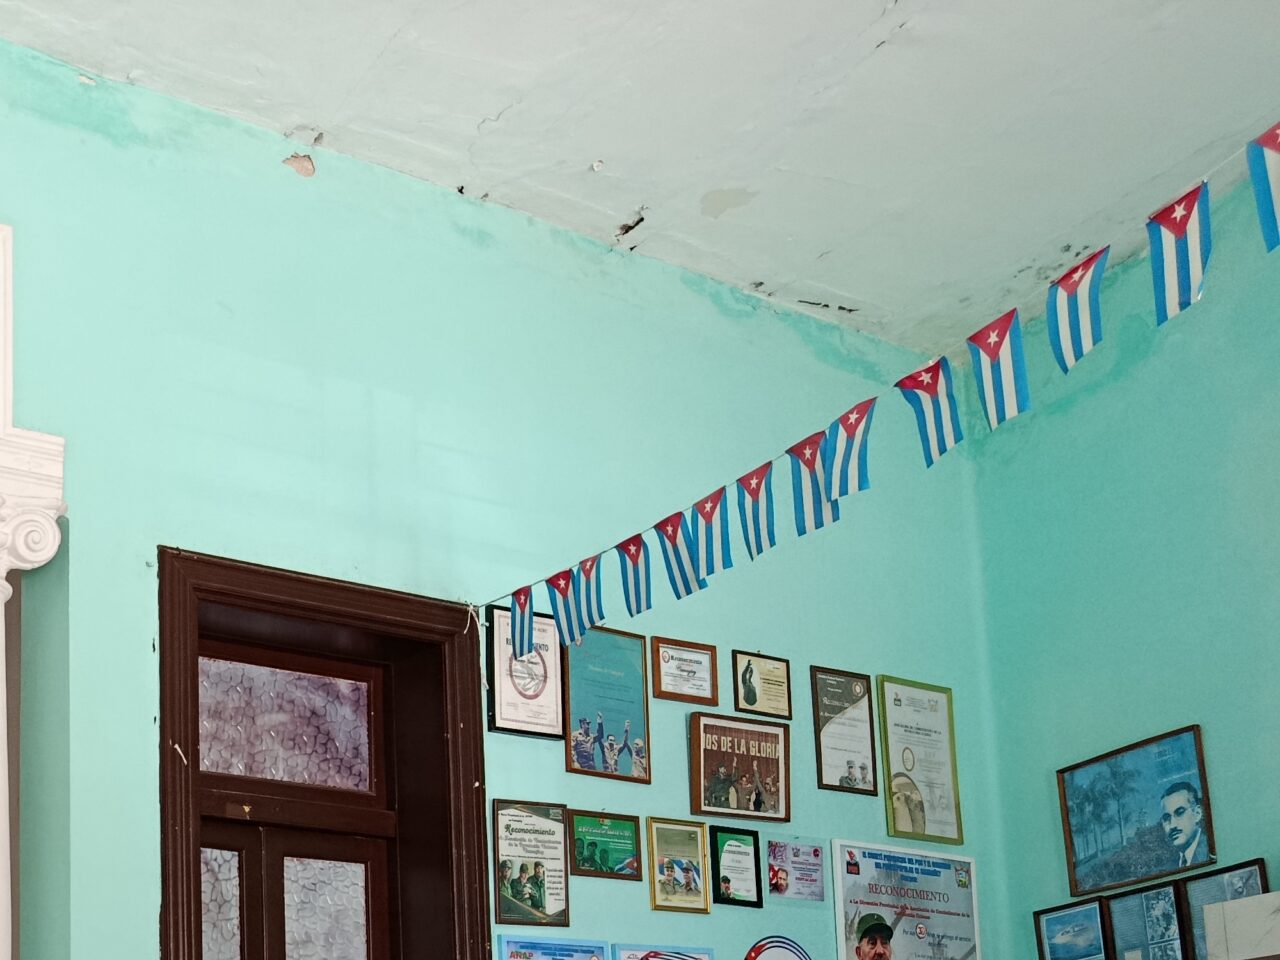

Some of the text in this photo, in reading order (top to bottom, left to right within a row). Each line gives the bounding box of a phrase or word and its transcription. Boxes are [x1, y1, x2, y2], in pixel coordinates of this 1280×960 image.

[720, 735, 733, 753] DE
[734, 737, 747, 755] LA
[867, 882, 950, 903] RECONOCIMIENTO
